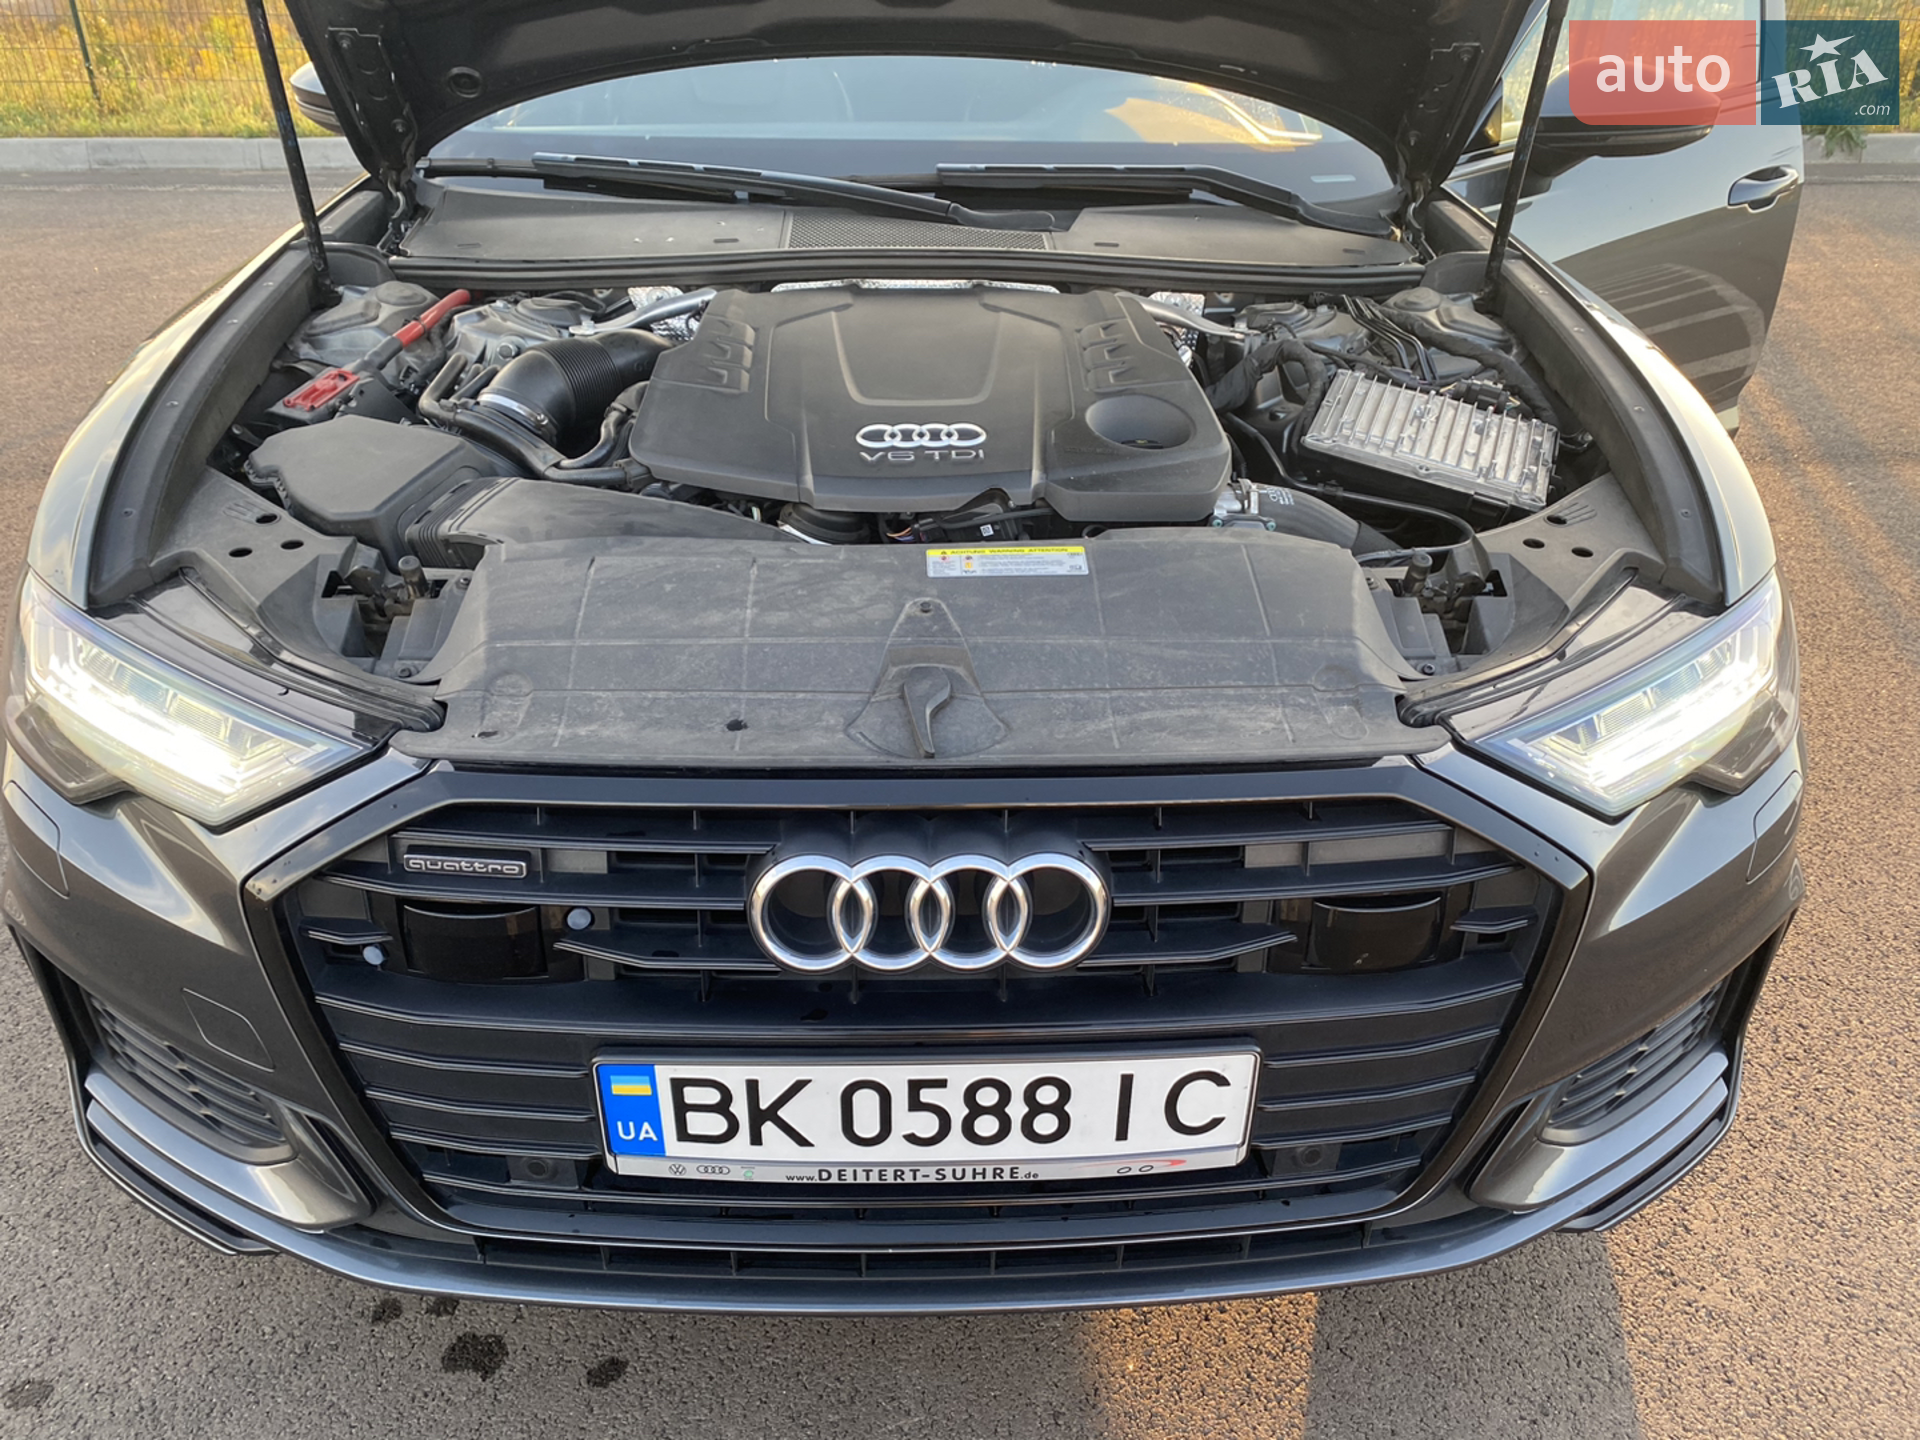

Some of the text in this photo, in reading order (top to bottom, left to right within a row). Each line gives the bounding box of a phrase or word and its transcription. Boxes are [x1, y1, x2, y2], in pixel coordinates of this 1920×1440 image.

[860, 449, 985, 461] V6 TDI
[409, 859, 520, 874] quattro
[617, 1120, 658, 1141] UA
[669, 1077, 815, 1147] BK
[840, 1077, 1072, 1148] 0588
[785, 1166, 1039, 1183] www.DEITERT-SUHRE.de
